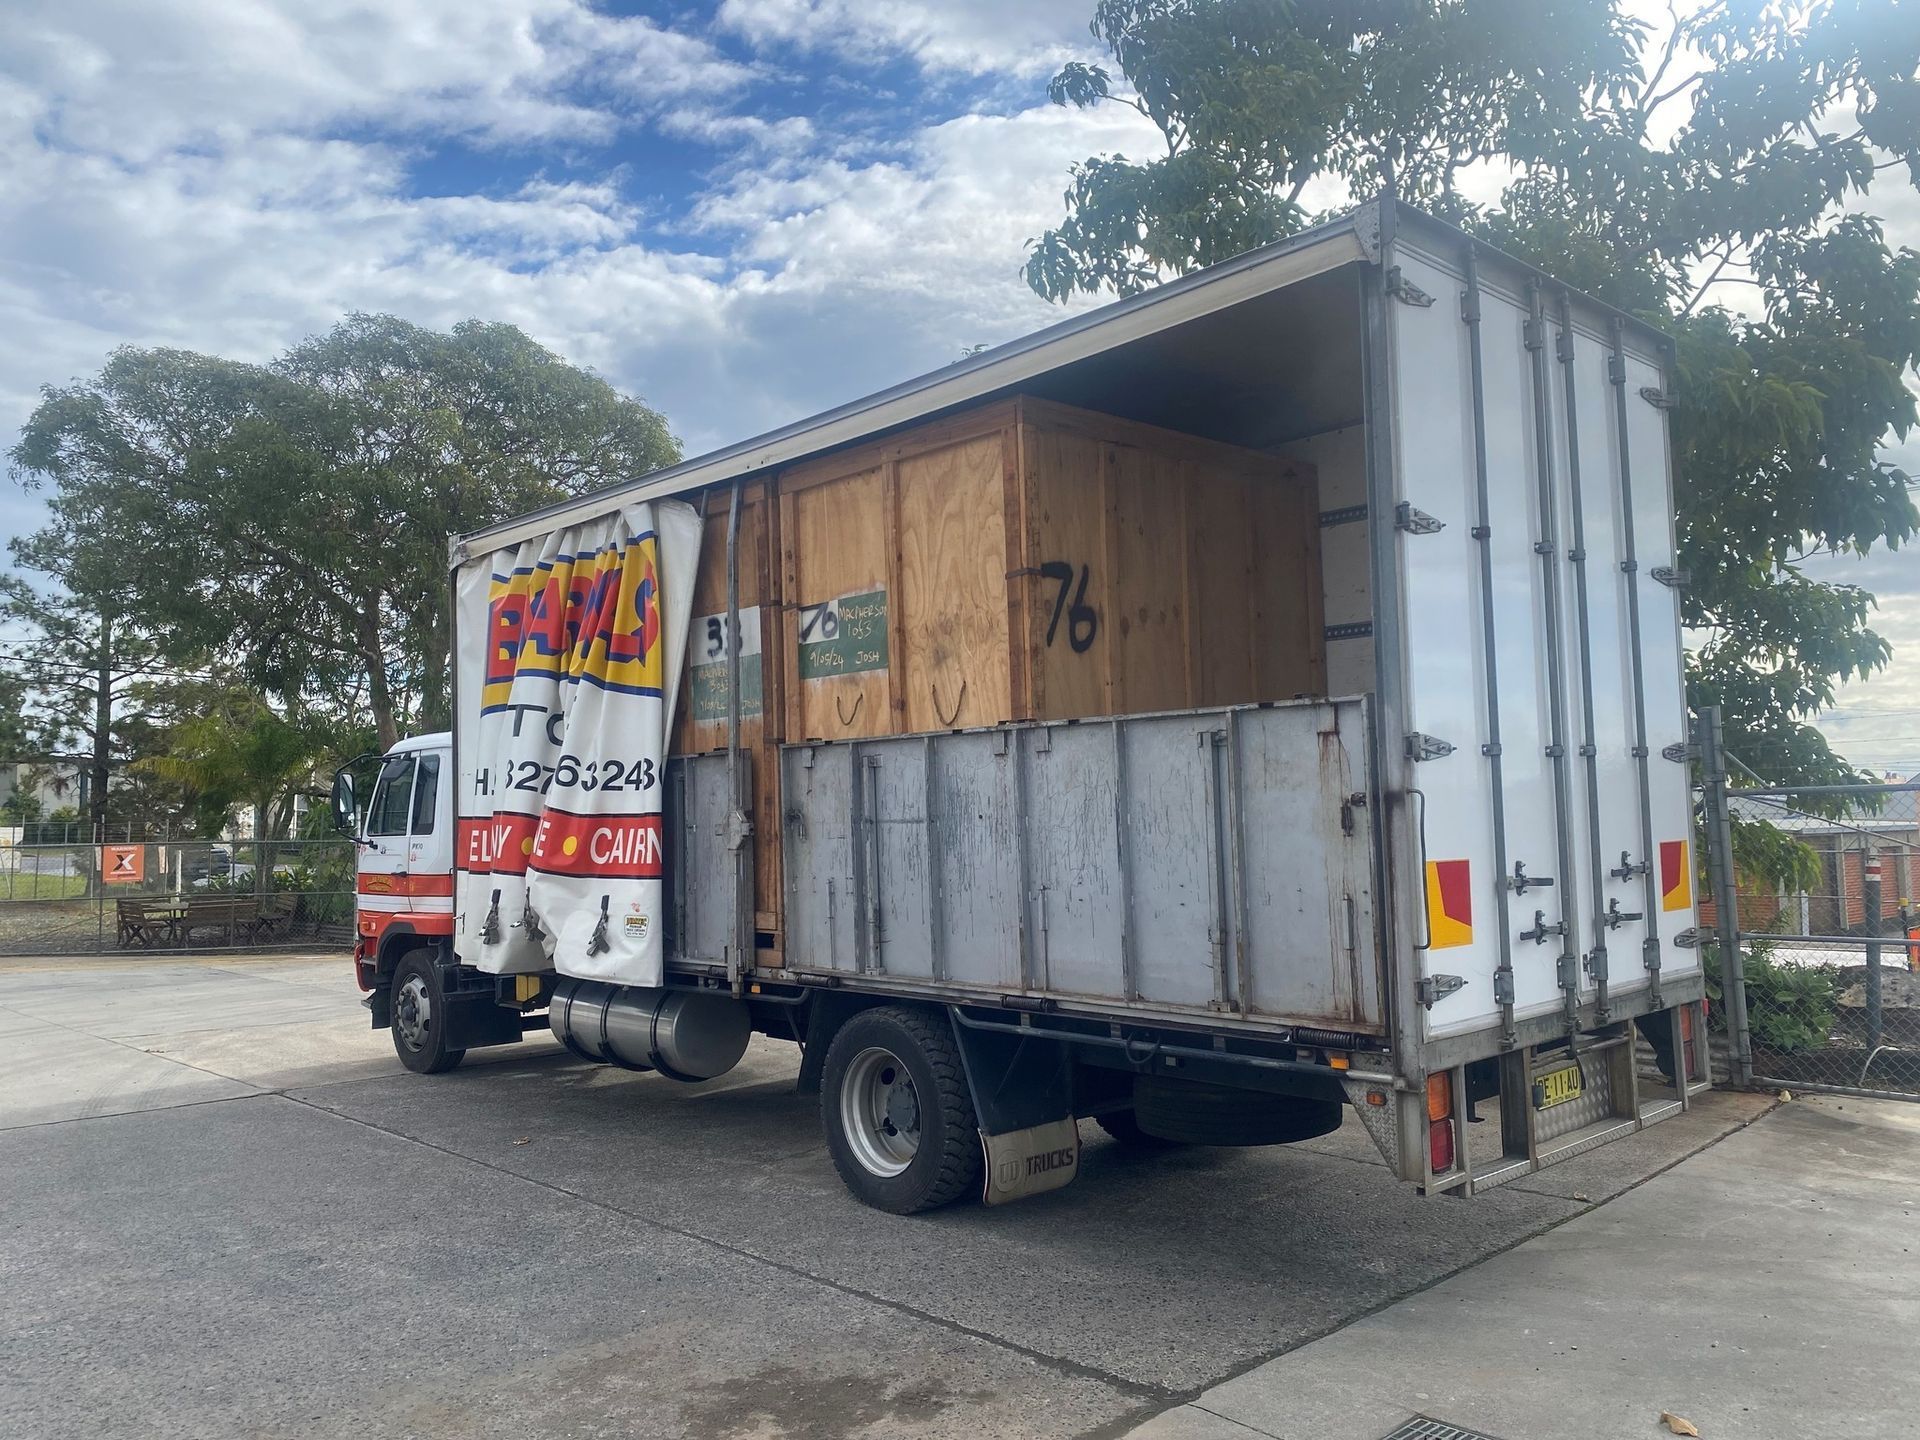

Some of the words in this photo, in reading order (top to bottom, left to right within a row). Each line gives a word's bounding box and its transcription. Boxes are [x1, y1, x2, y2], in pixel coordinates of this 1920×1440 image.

[799, 602, 839, 643] 76
[1032, 561, 1097, 654] 76
[707, 616, 743, 657] 3
[855, 651, 880, 664] JOSH
[1026, 1147, 1074, 1176] TRUCKS
